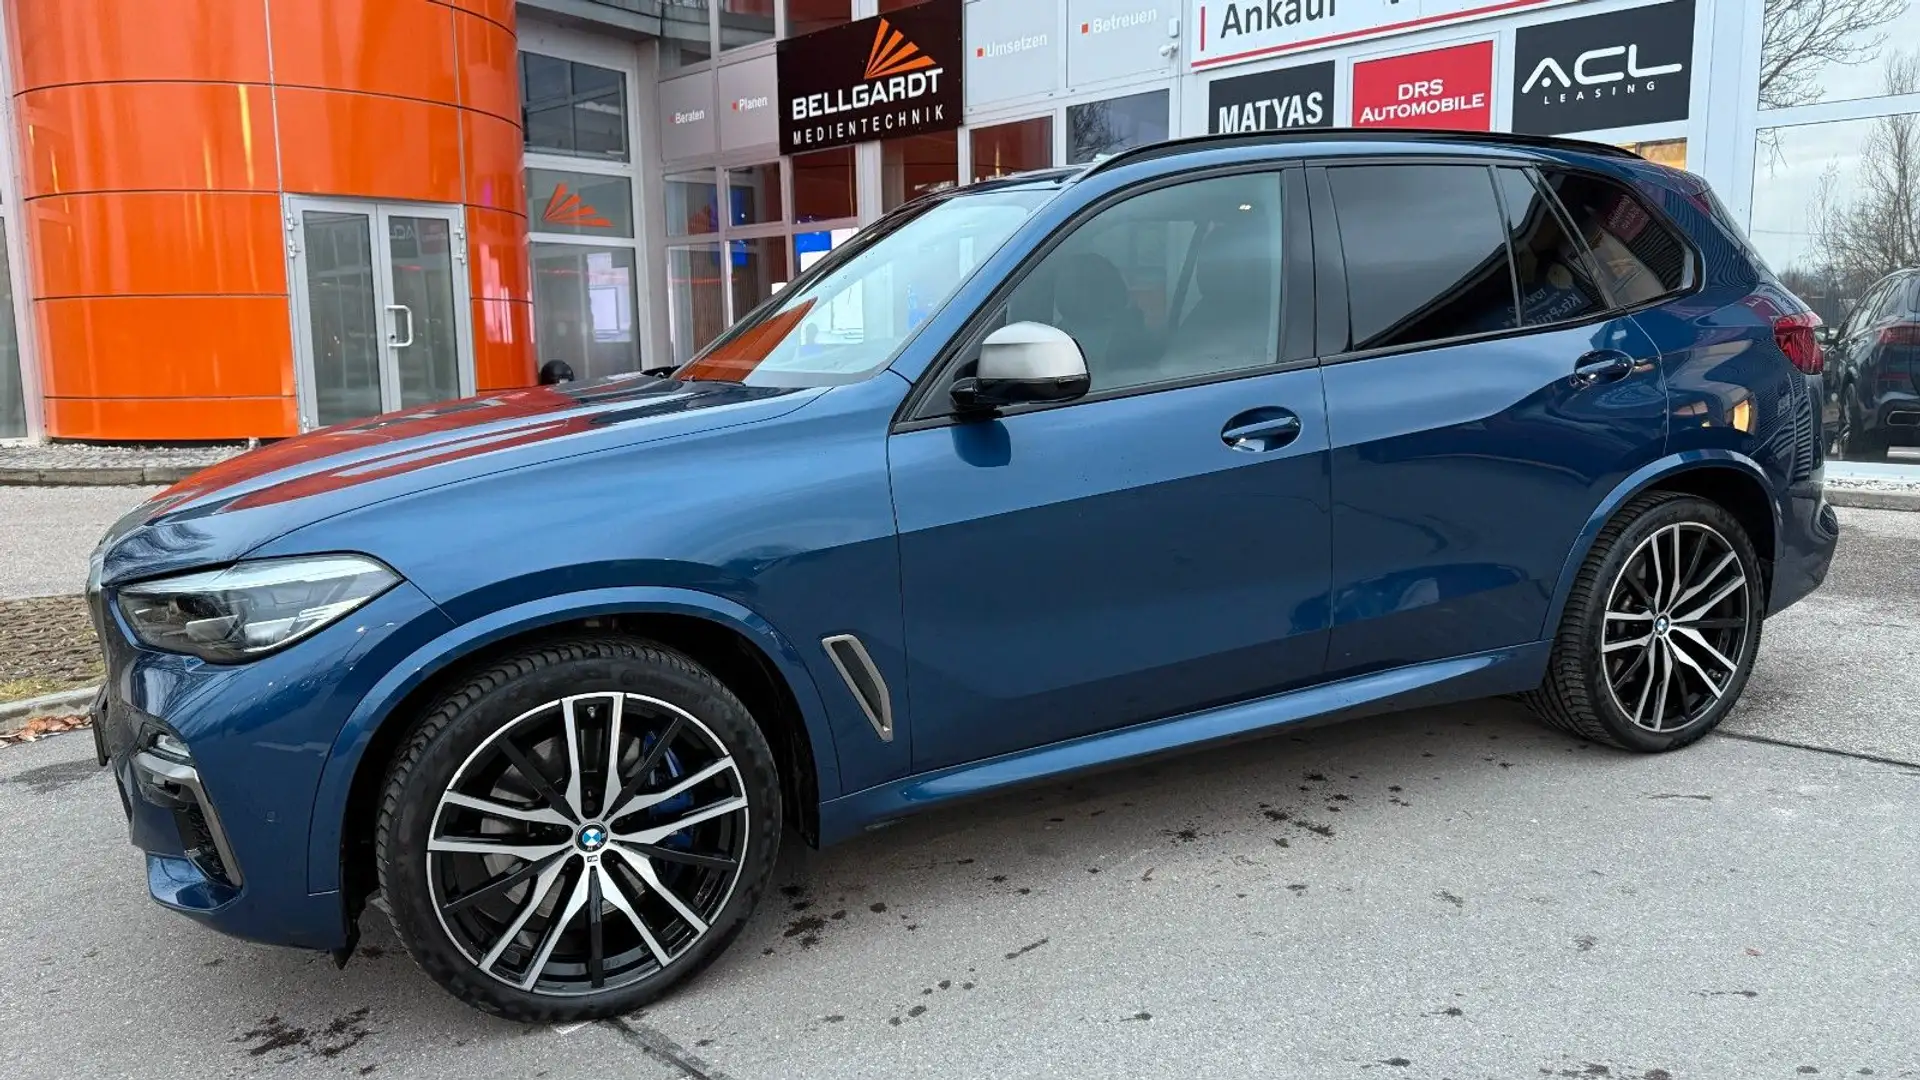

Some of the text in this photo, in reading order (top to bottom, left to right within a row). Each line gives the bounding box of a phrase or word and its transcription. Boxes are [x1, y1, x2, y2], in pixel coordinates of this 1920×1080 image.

[1092, 7, 1157, 34] Betreuen
[986, 32, 1048, 58] Umsetzen
[1521, 44, 1682, 94] ACL
[738, 95, 768, 110] Planen
[792, 67, 943, 120] BELLGARDT
[1397, 78, 1444, 101] DRS
[1543, 81, 1656, 105] LEASING
[1218, 91, 1323, 134] MATYAS
[1359, 92, 1485, 123] AUTOMOBILE
[793, 103, 944, 145] MEDIENTECHNIK
